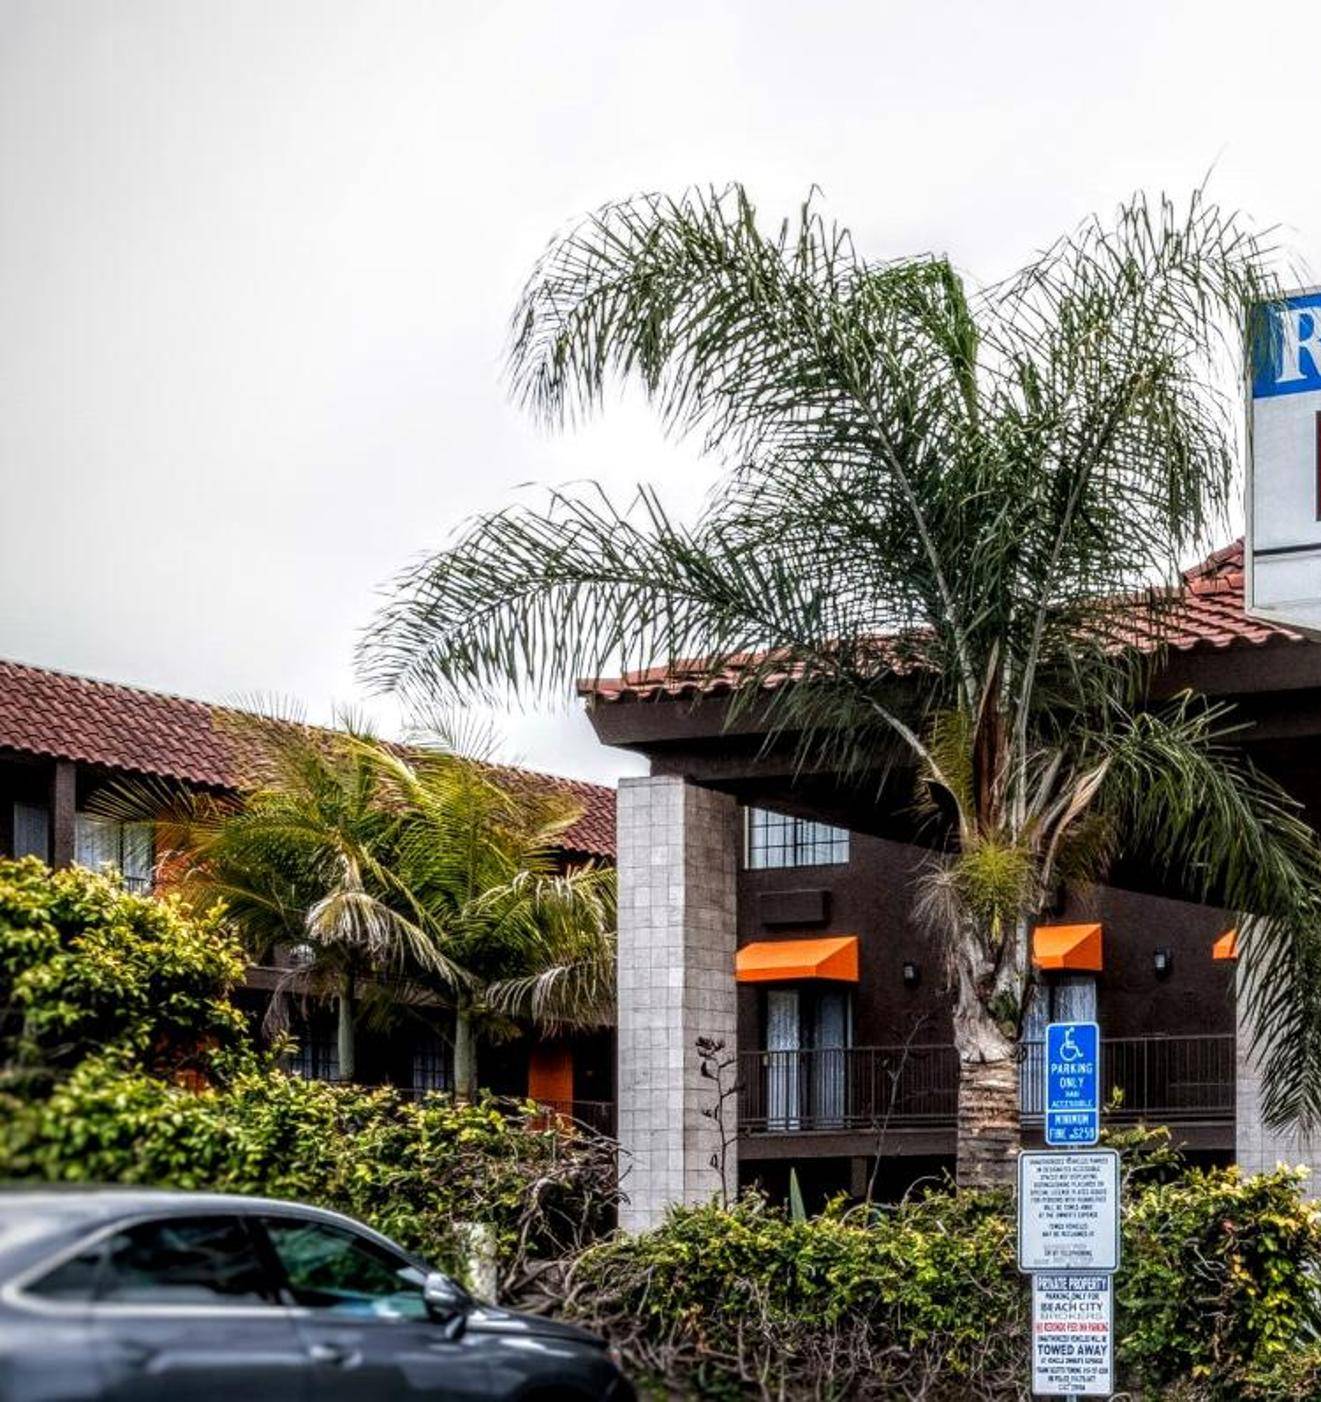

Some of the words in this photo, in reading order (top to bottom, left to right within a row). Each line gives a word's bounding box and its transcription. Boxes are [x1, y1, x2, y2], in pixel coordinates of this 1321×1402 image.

[1051, 1063, 1094, 1075] PARKING
[1060, 1077, 1085, 1089] ONLY
[1054, 1114, 1090, 1126] MINIMUM
[1038, 1277, 1068, 1290] PRIVATE
[1068, 1277, 1107, 1290] PROPERTY
[1040, 1302, 1077, 1312] BEACH
[1079, 1302, 1104, 1312] CITY
[1037, 1344, 1075, 1356] TOWED
[1077, 1344, 1108, 1356] AWAY
